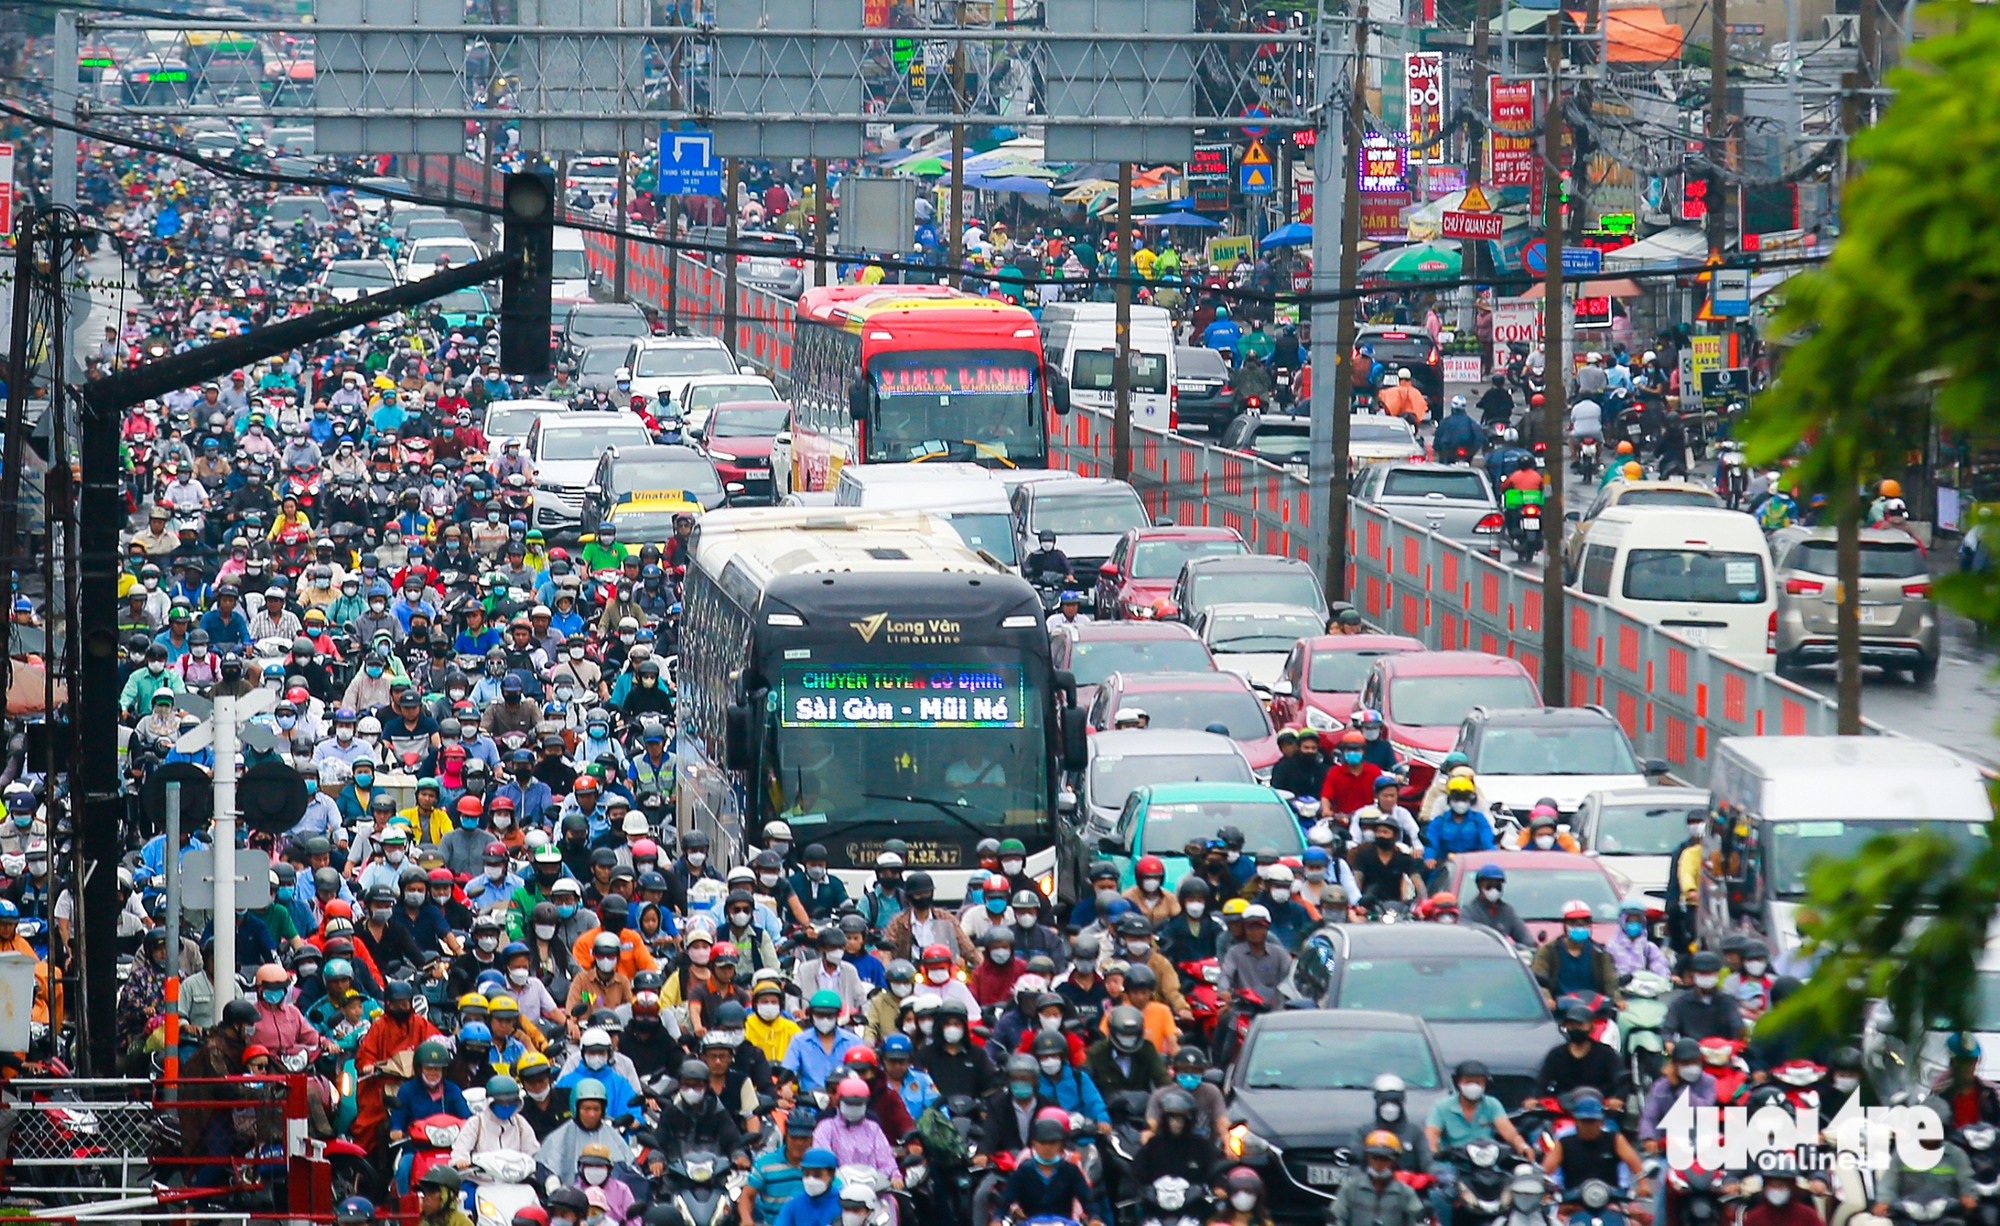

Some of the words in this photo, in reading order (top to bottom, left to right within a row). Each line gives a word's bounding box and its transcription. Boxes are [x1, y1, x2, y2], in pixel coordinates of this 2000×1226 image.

[1465, 217, 1484, 235] QUAN
[1486, 217, 1501, 235] SÁT
[1213, 243, 1236, 262] BÁNH
[1494, 322, 1533, 343] CƠM
[634, 490, 681, 501] Vinataxi
[886, 620, 925, 636] Long
[928, 619, 960, 633] Vân
[886, 635, 961, 644] Limousine
[796, 696, 837, 720] Sài
[842, 696, 894, 720] Gòn
[920, 696, 967, 720] Mũi
[973, 696, 1009, 720] Né
